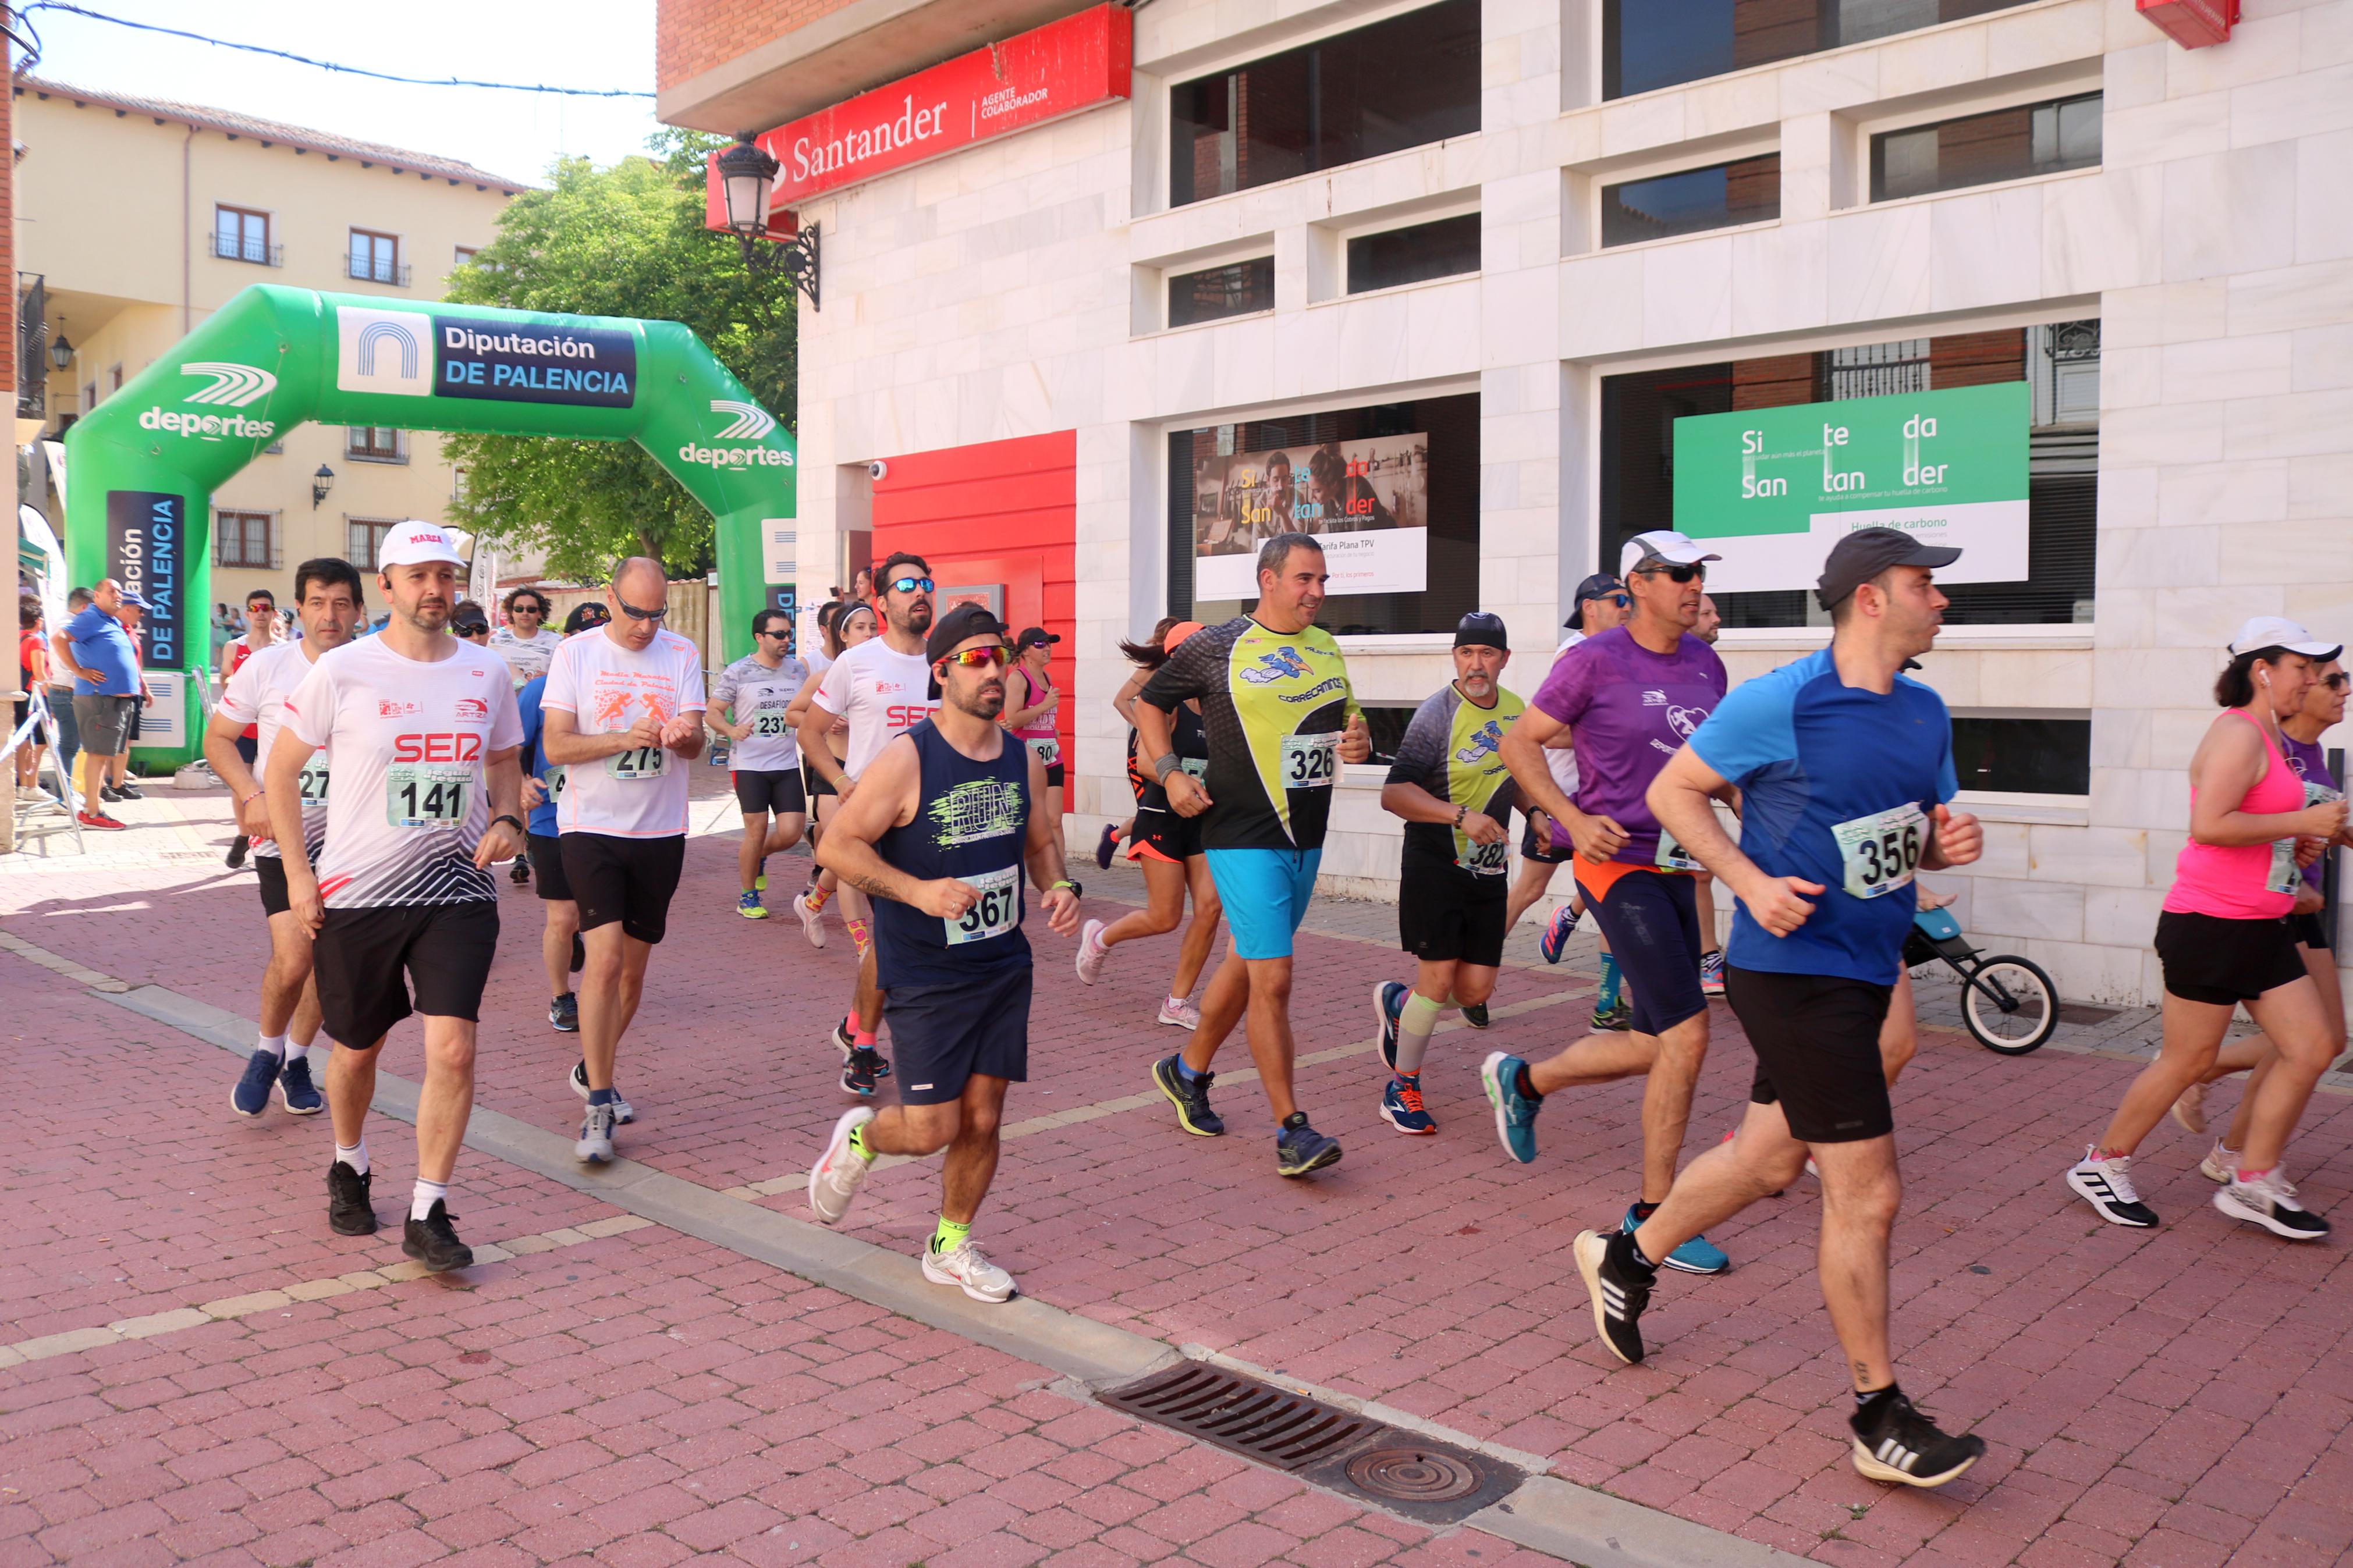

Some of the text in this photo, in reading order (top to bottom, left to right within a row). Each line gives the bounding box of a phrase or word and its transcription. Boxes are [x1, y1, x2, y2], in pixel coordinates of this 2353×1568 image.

[981, 87, 1048, 119] COLABORADOR
[982, 86, 1016, 108] AGENTE
[793, 93, 947, 183] Santander
[444, 326, 595, 359] Diputación
[445, 360, 629, 394] DE PALENCIA
[139, 406, 275, 440] deportes
[1742, 414, 1937, 454] Si te da
[679, 442, 794, 471] deportes
[1241, 457, 1369, 489] Si te da
[1742, 460, 1949, 499] San tan der
[1241, 497, 1375, 524] San tan der
[1826, 494, 1844, 503] ayuda
[1850, 490, 1883, 500] compensar
[1922, 486, 1949, 494] carbono
[1362, 514, 1375, 522] Pagos
[1888, 520, 1901, 529] de
[1904, 518, 1947, 529] carbono
[1319, 539, 1375, 550] Tarifa Plana TPV
[1915, 531, 1948, 539] emisiones
[152, 500, 173, 660] DE PALENCIA
[599, 670, 672, 682] Media Maratón
[640, 680, 676, 692] Palencia
[394, 733, 482, 762] SER
[617, 746, 662, 771] 275
[1290, 747, 1334, 780] 326
[400, 782, 462, 819] 141
[949, 782, 1015, 835] RUN
[1859, 826, 1919, 886] 356
[959, 885, 1013, 932] 367
